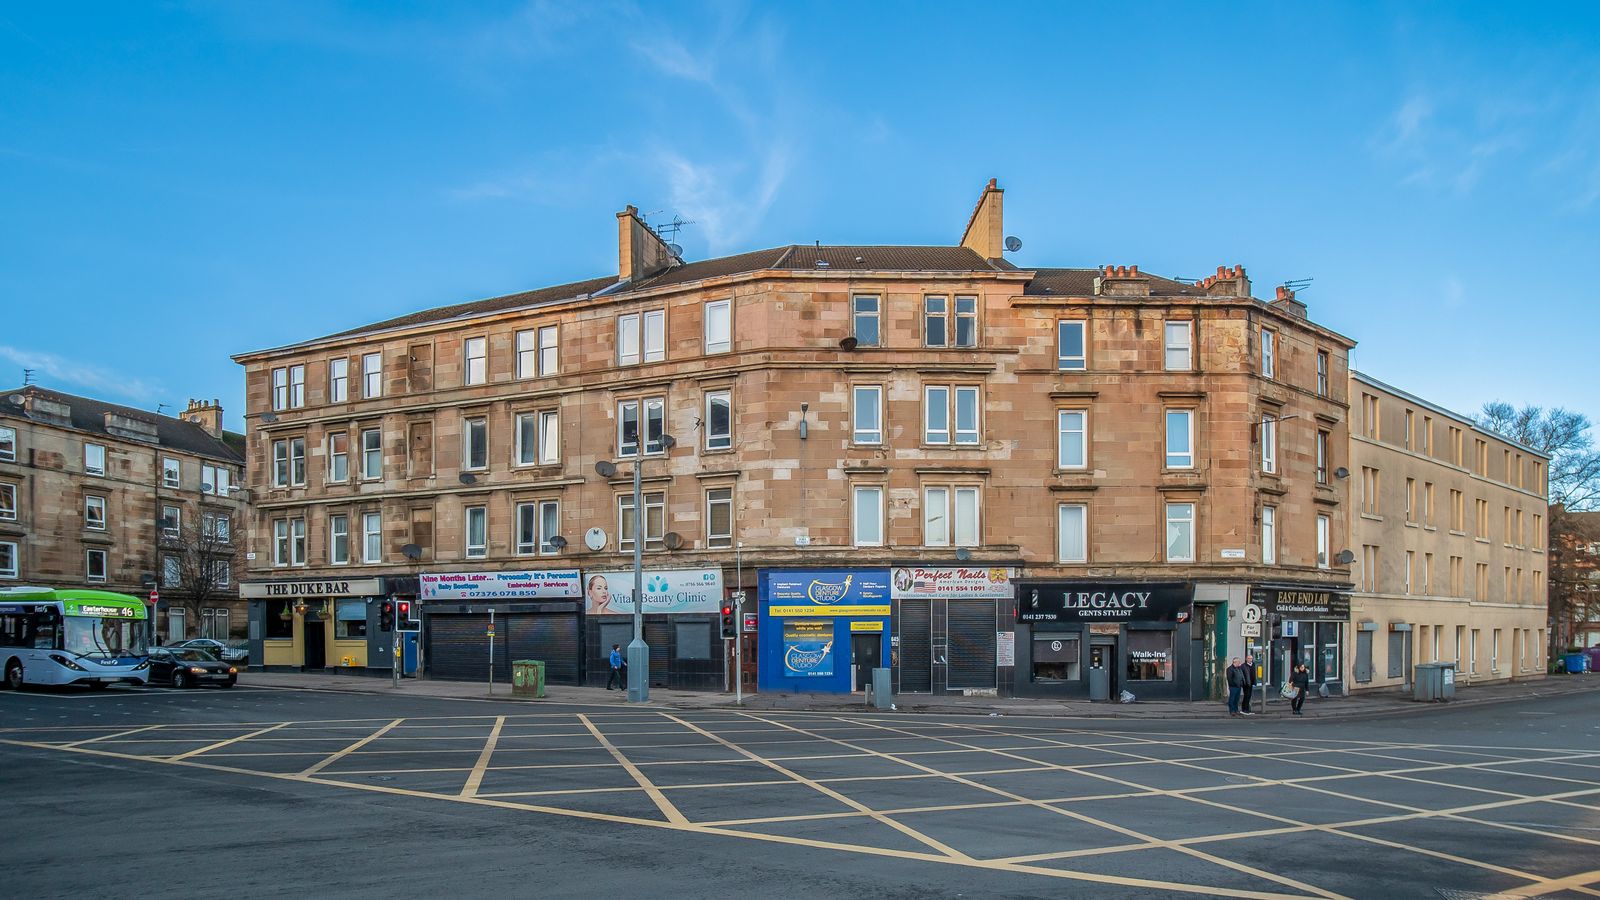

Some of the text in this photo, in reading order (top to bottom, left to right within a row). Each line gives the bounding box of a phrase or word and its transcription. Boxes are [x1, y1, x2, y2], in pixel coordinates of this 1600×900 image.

[914, 569, 986, 582] Perfect Nails
[265, 582, 350, 595] THE DUKE BAR
[612, 592, 706, 605] Vita Beauty Clinic
[1063, 592, 1151, 608] LEGACY
[1278, 592, 1297, 603] EAST
[1298, 592, 1313, 604] END
[1314, 594, 1329, 605] LAW
[122, 608, 133, 616] 46
